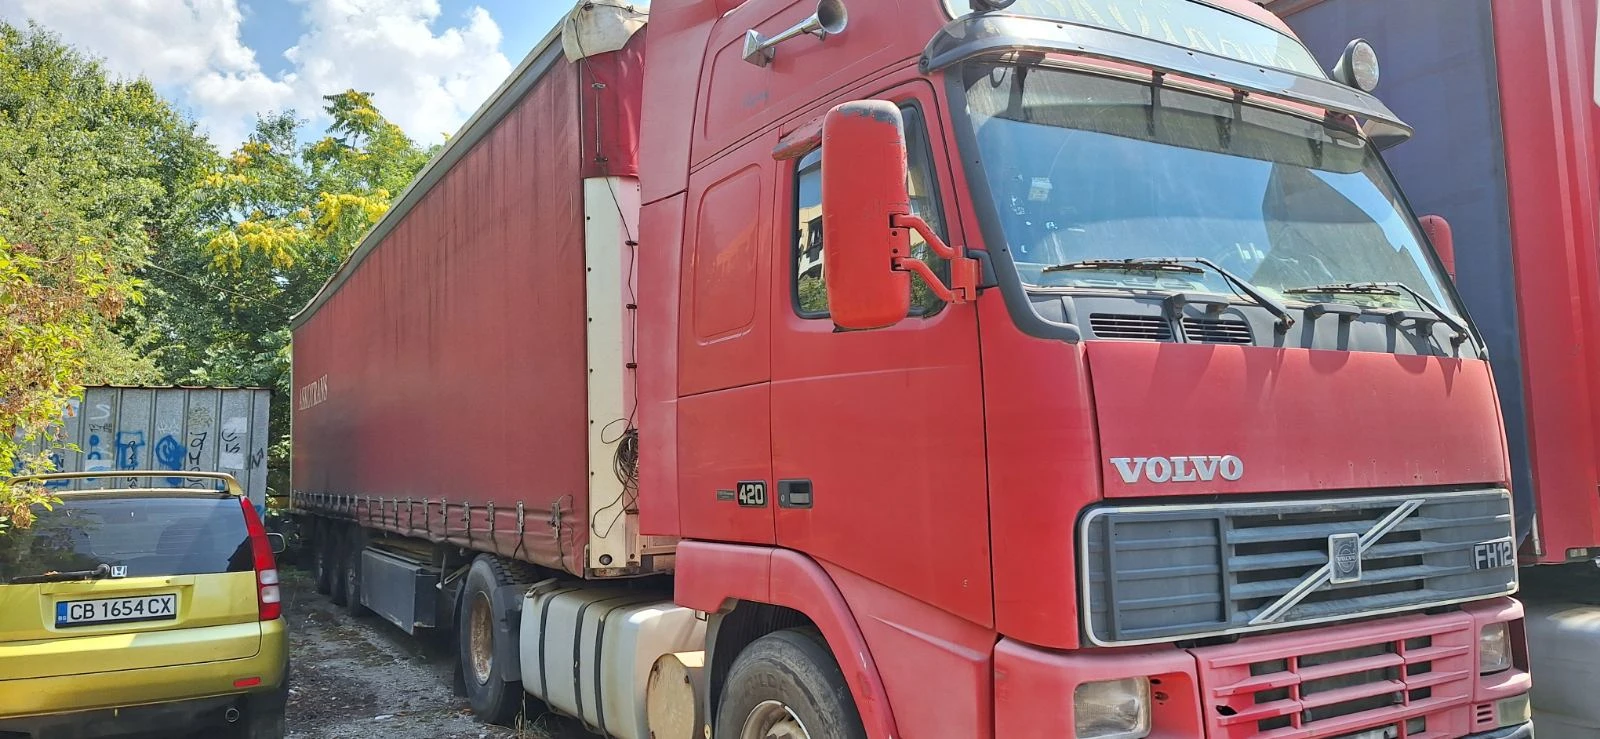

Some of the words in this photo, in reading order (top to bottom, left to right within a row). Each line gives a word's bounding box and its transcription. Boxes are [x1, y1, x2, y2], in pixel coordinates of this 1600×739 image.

[1109, 455, 1244, 483] VOLVO
[739, 484, 764, 505] 420
[1474, 541, 1512, 570] FH12
[70, 603, 95, 620] CB
[101, 599, 144, 618] 1654
[147, 597, 171, 614] CX
